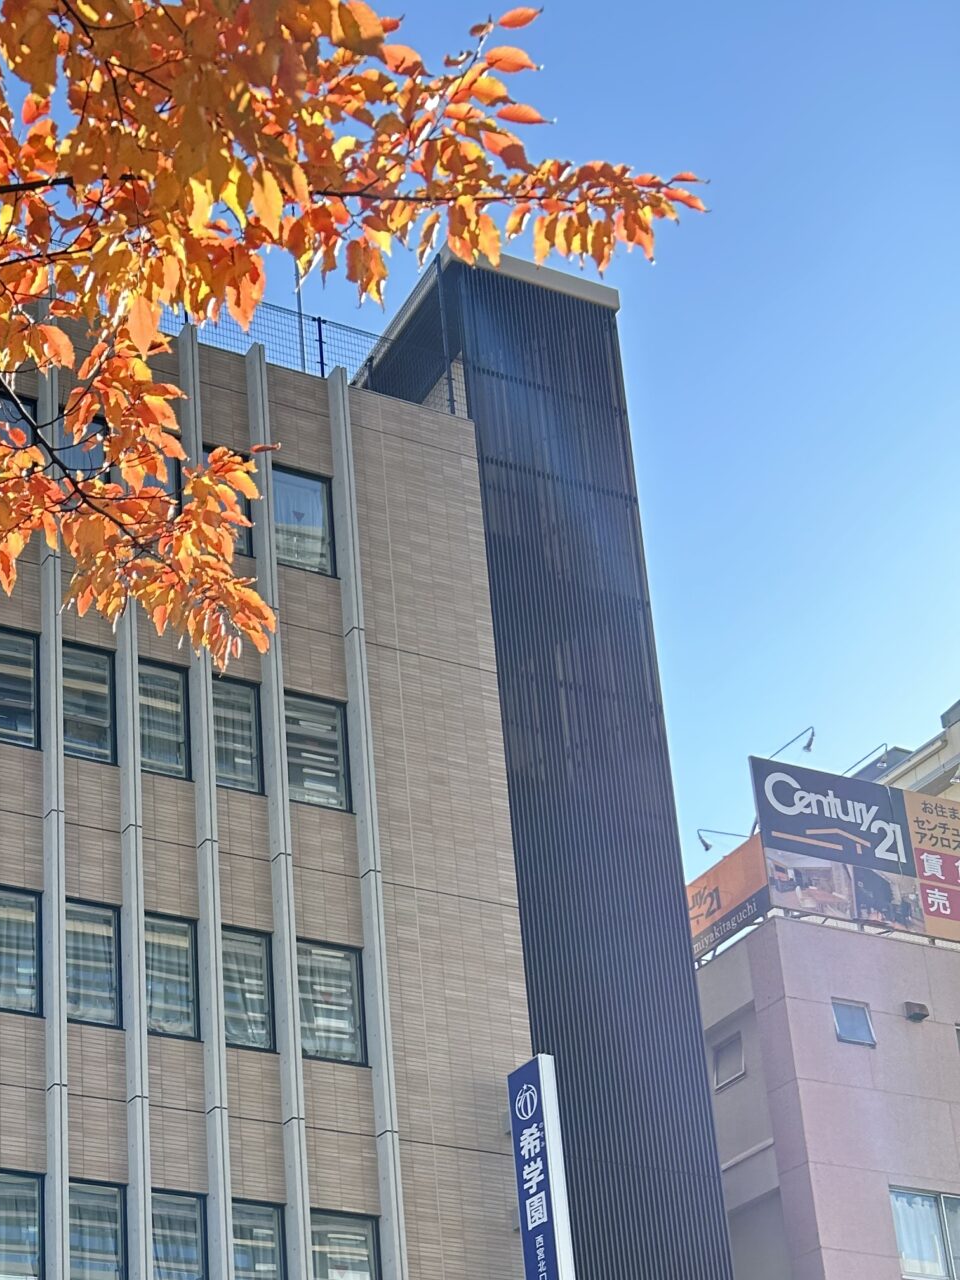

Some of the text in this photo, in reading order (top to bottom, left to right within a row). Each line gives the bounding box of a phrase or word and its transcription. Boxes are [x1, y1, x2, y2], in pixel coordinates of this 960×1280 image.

[764, 772, 907, 863] Century 21
[519, 1121, 548, 1232] 希学園
